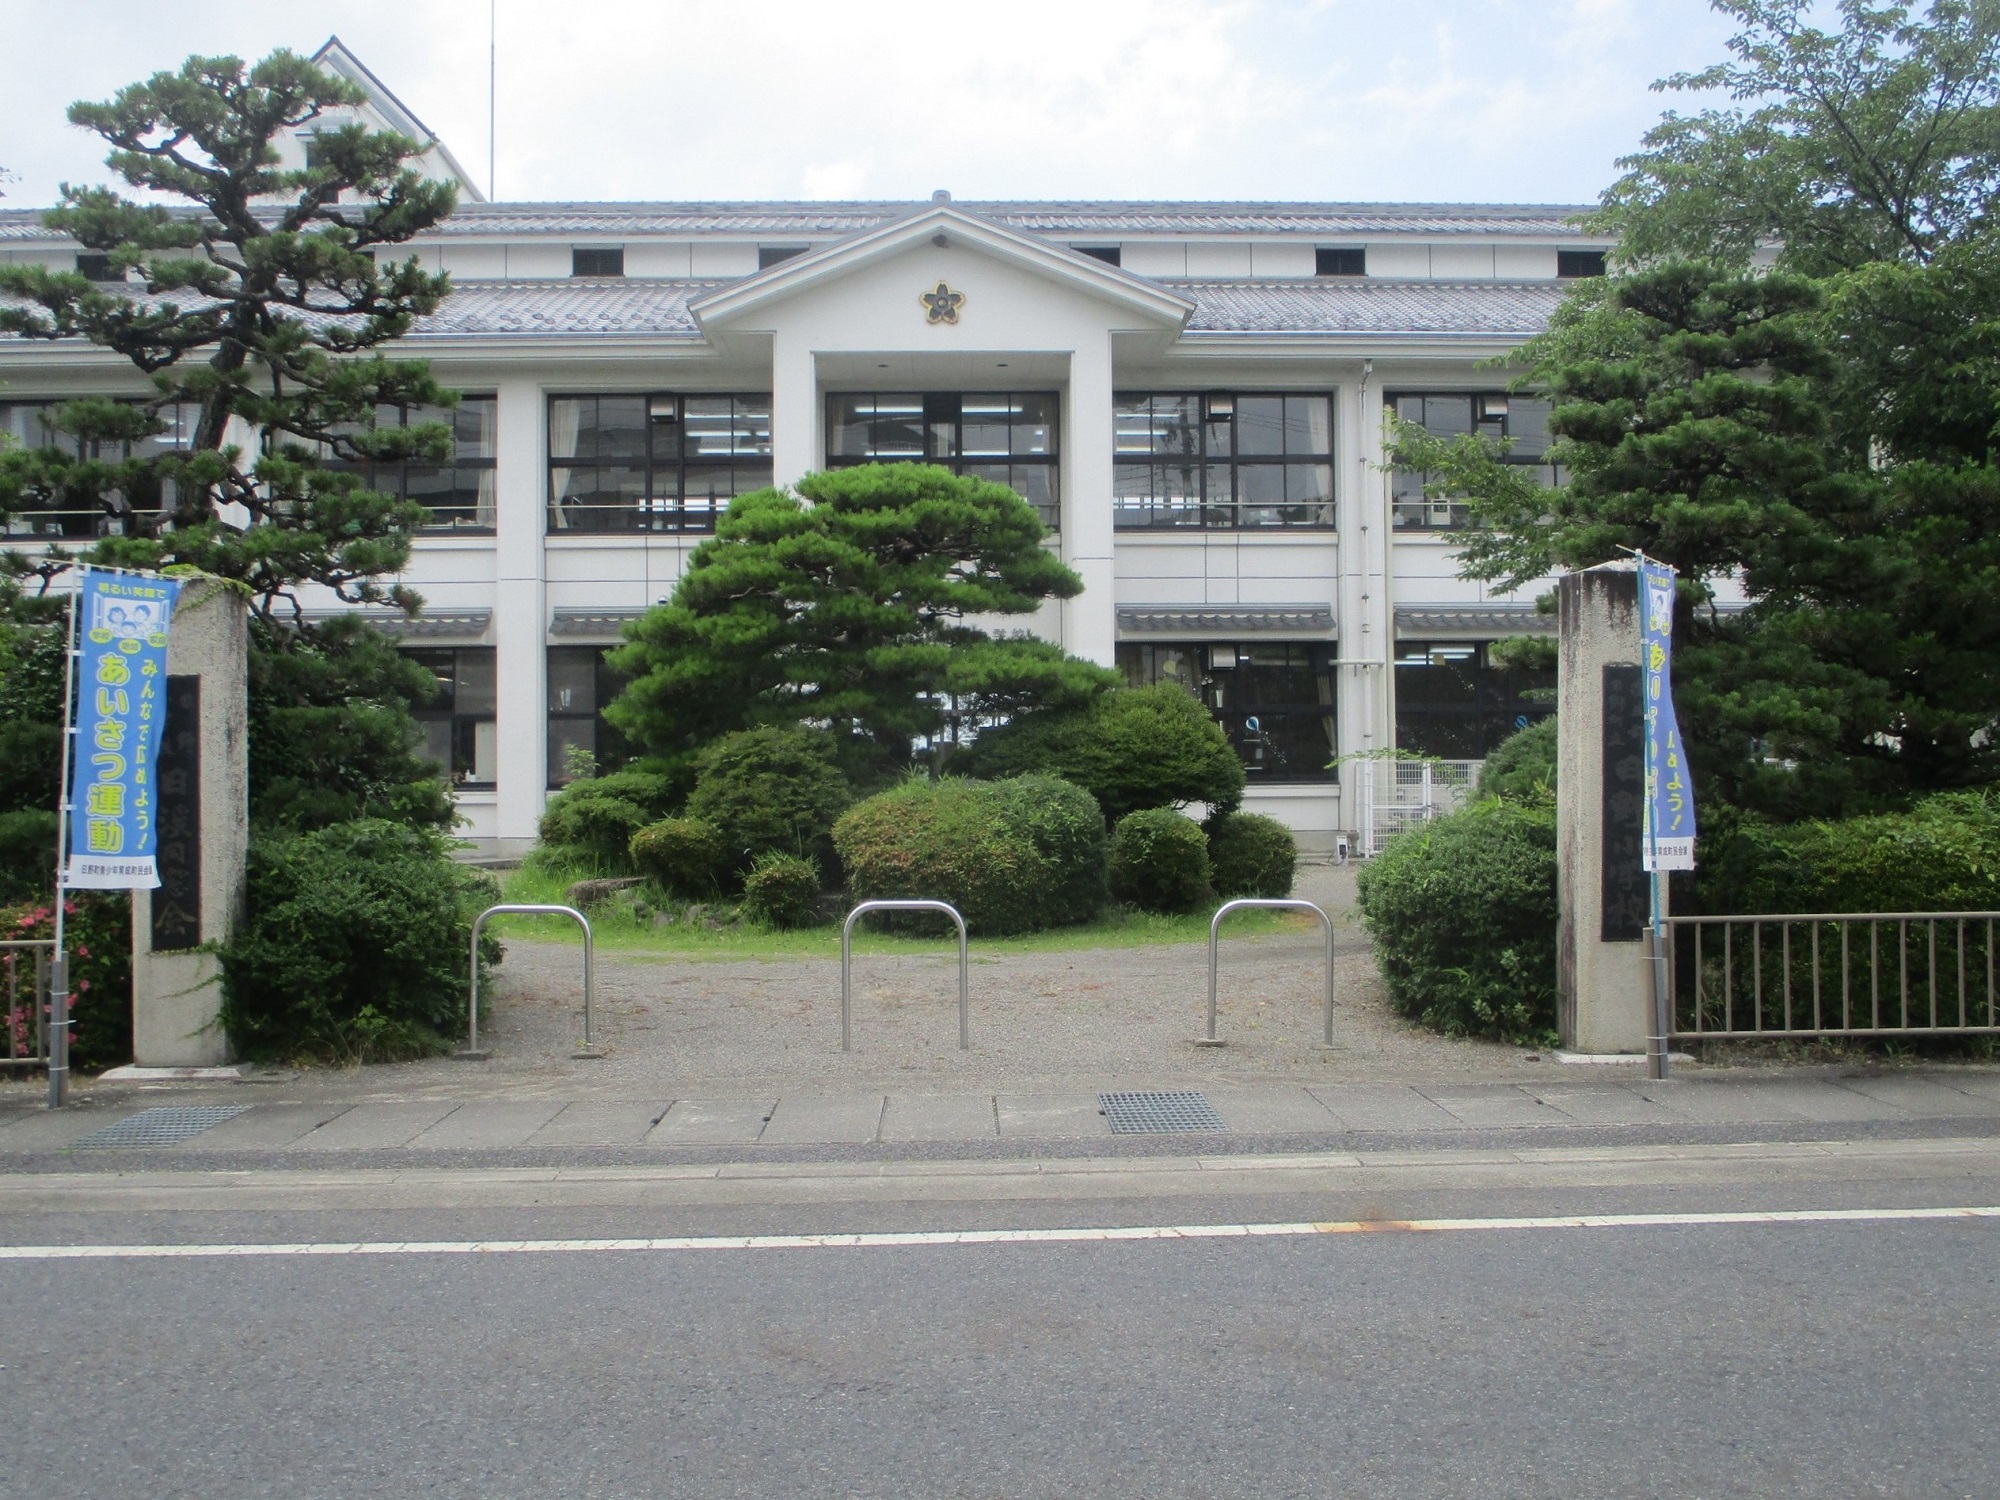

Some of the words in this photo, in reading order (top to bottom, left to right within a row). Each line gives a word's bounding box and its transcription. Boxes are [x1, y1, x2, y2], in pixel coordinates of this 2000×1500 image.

[85, 652, 131, 854] あいさつ運動
